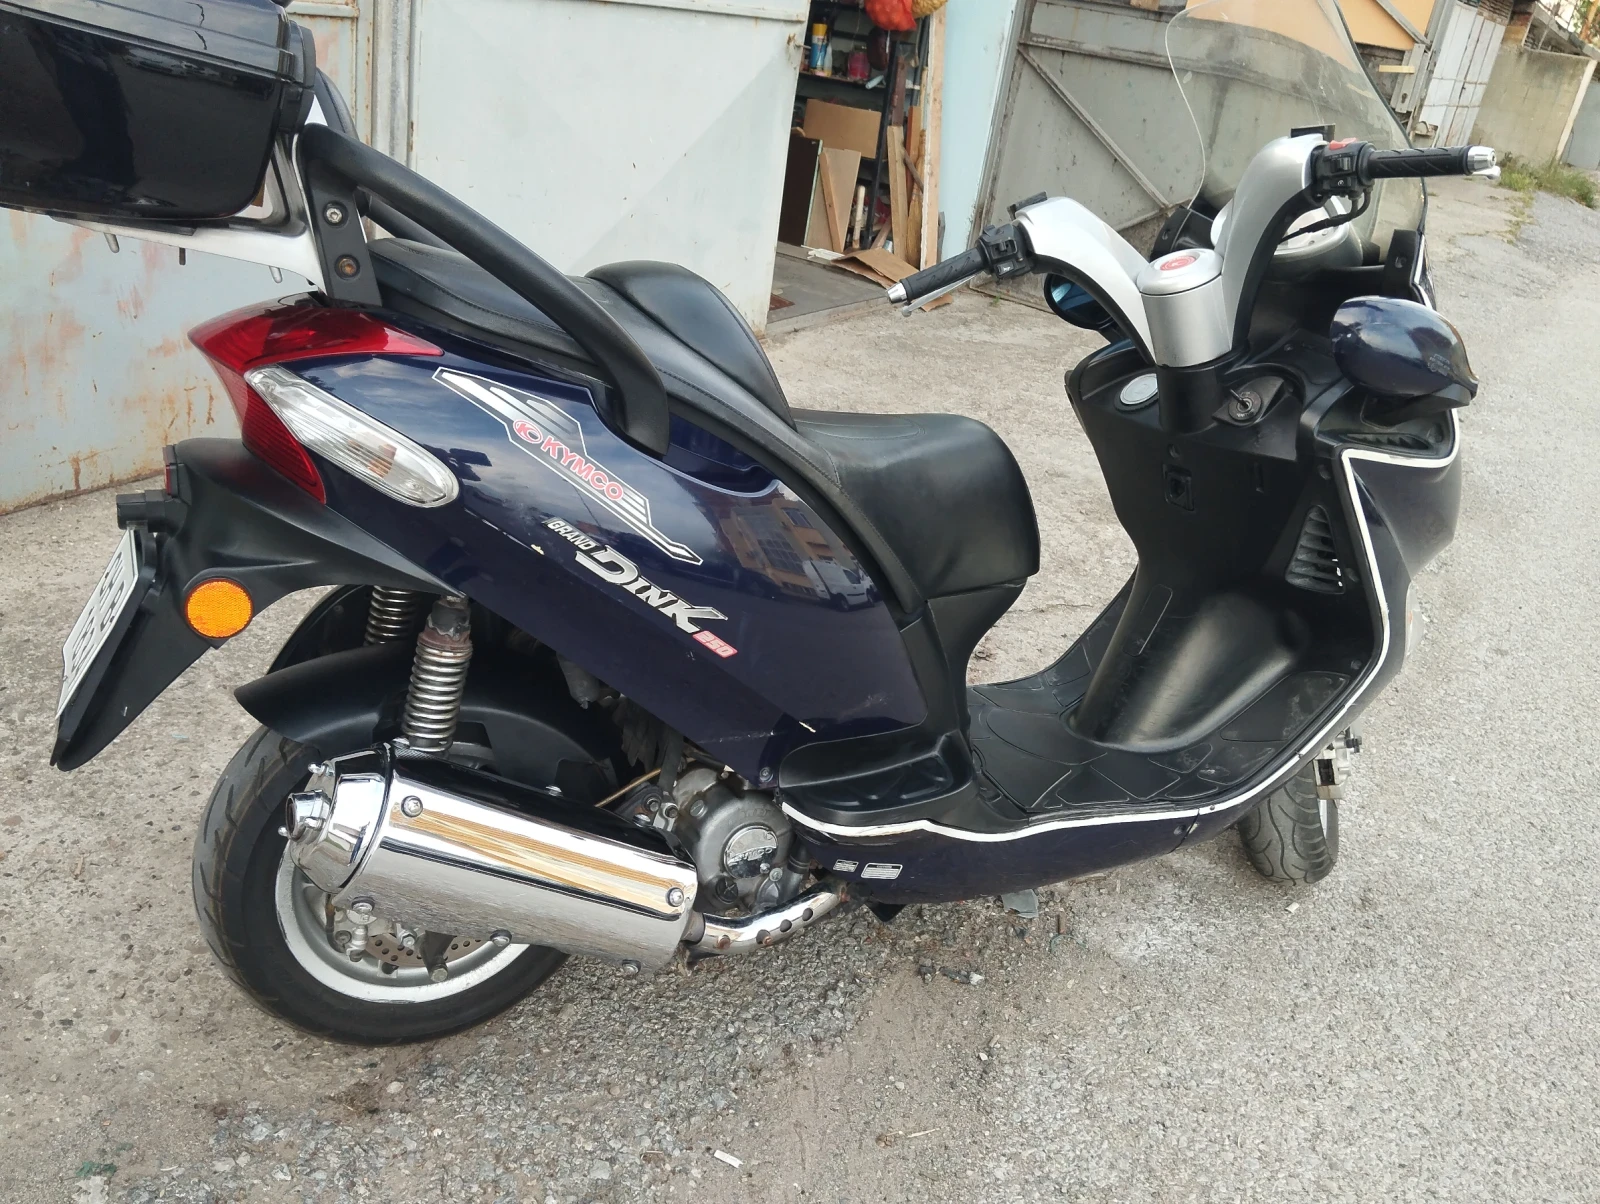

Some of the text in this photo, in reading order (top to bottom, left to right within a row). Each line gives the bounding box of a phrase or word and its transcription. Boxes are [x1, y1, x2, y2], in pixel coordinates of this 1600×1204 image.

[540, 435, 624, 500] KYMCO
[547, 519, 597, 551] GRAND
[695, 631, 735, 658] 250
